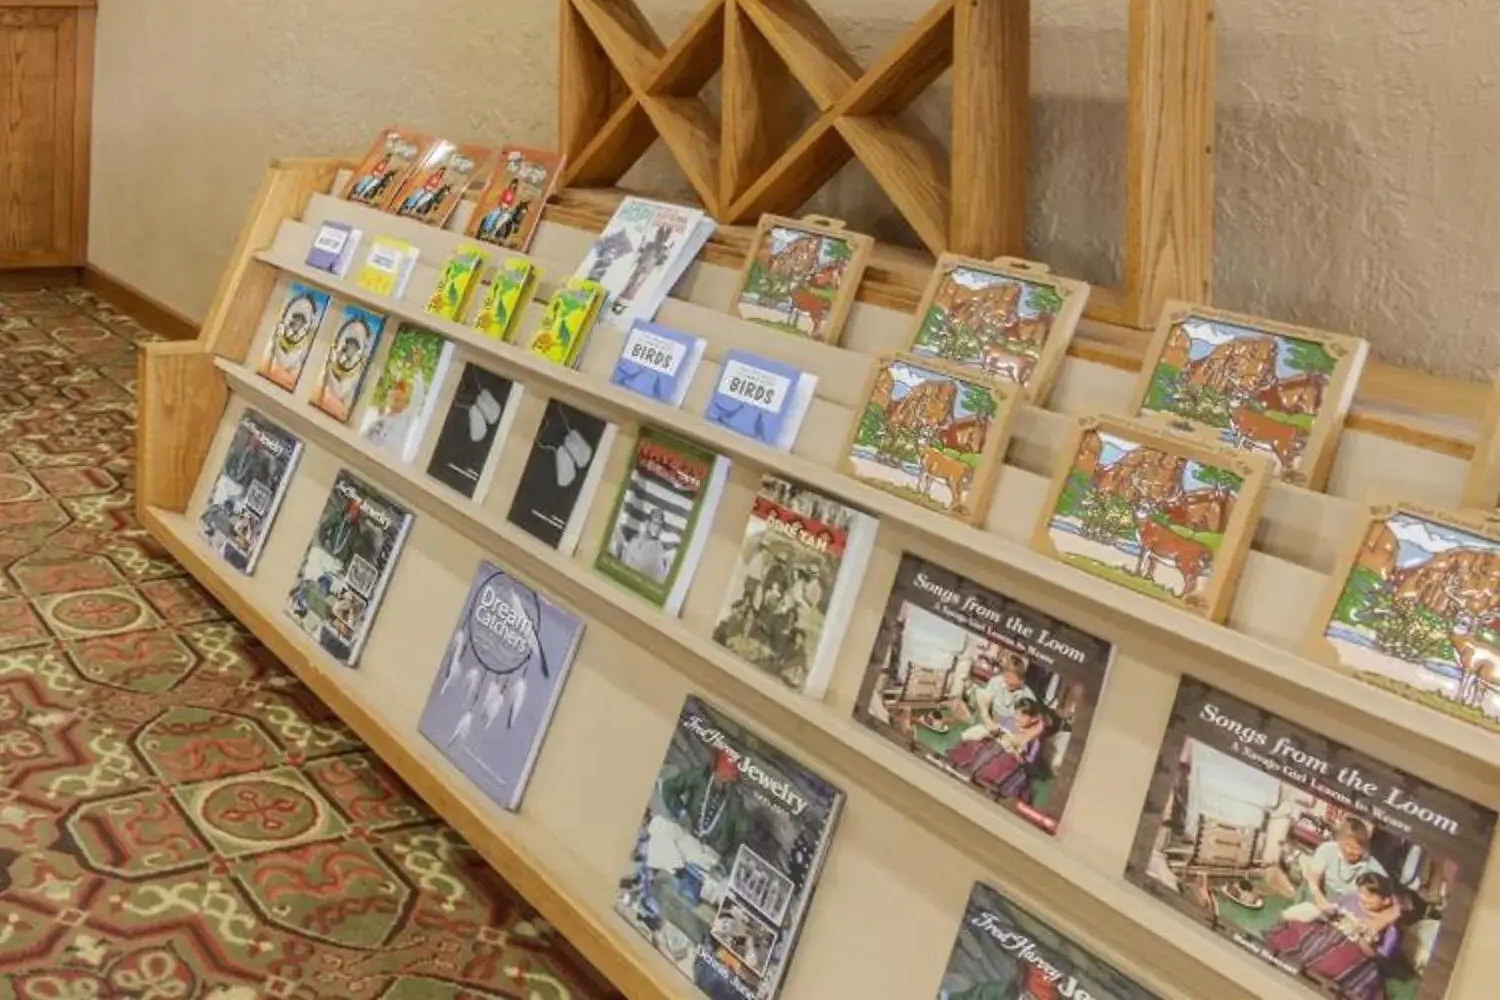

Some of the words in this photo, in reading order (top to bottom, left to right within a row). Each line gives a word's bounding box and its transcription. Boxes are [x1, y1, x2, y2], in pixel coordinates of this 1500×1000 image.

[631, 343, 674, 369] BIRDS
[729, 377, 775, 404] BIRDS
[913, 572, 961, 604] Songs
[963, 596, 1002, 624] from
[1005, 615, 1033, 638] the
[1037, 629, 1086, 663] Loom
[737, 756, 808, 816] Jewelry
[1199, 702, 1268, 746] Songs
[1269, 736, 1331, 776] from
[1336, 765, 1380, 797] the
[1385, 786, 1461, 836] Loom
